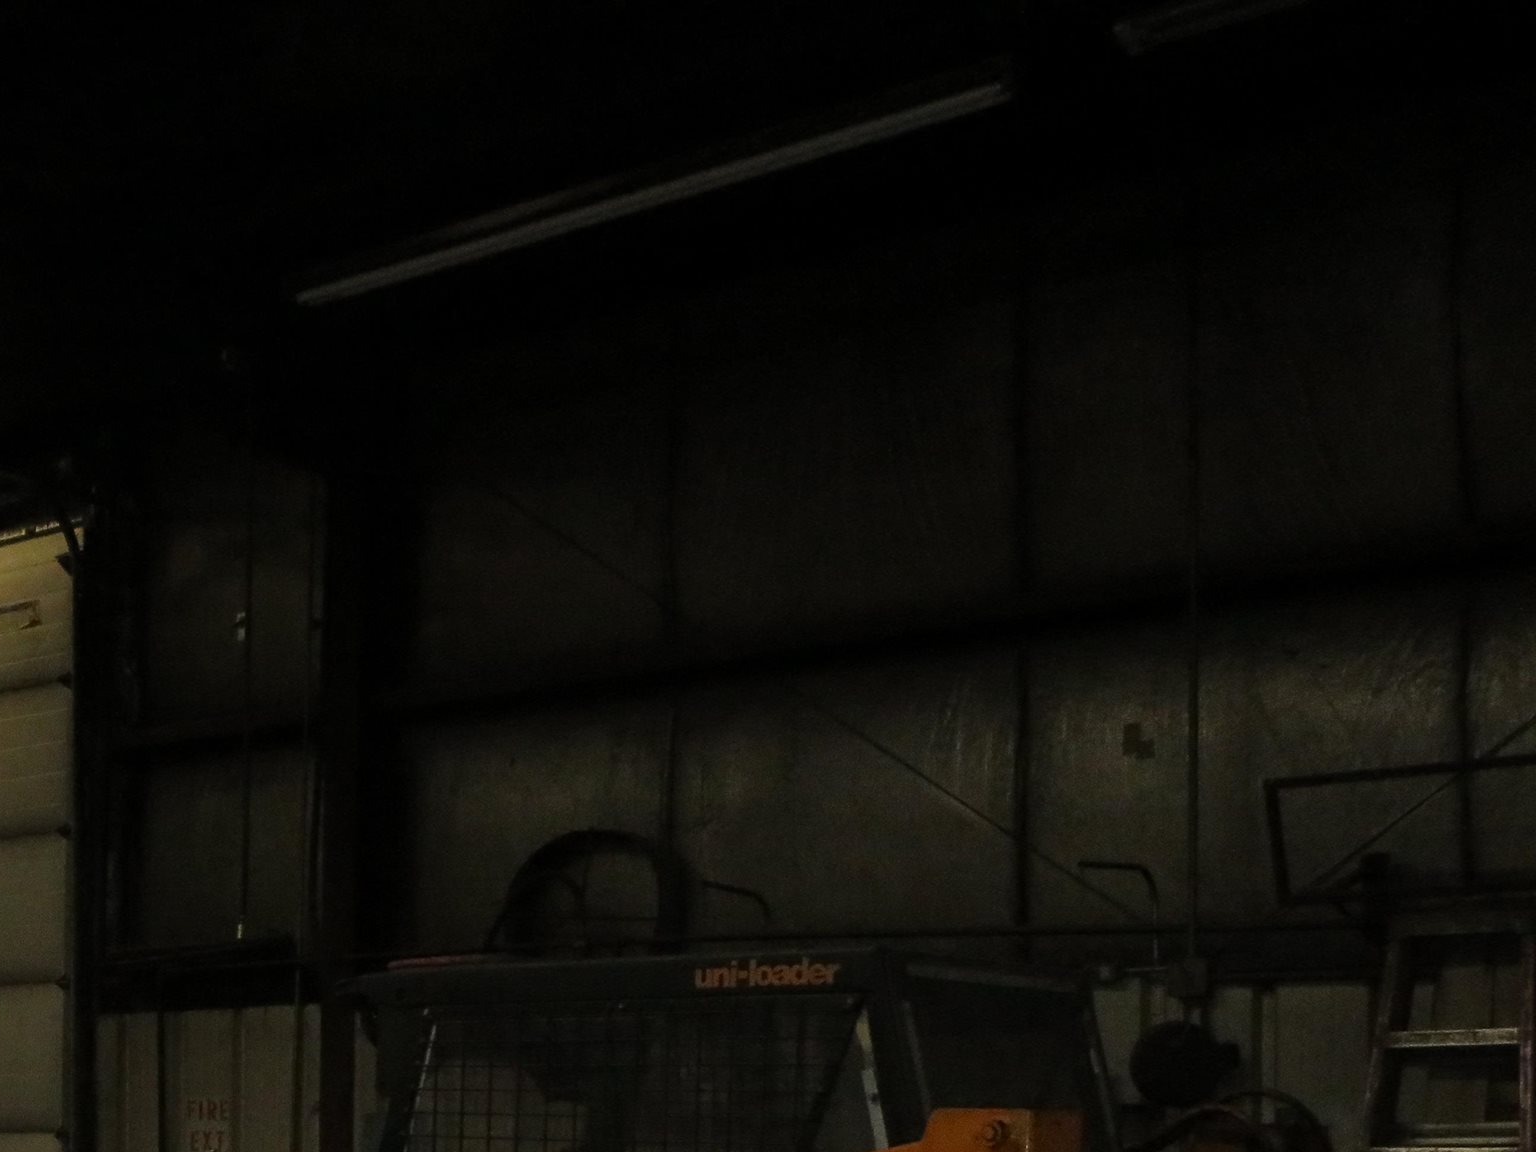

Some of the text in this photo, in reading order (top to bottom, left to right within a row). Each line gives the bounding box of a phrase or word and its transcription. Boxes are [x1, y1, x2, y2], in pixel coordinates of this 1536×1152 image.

[694, 956, 842, 989] uni-loader
[187, 1099, 230, 1121] FIRE
[190, 1131, 225, 1151] EXT
